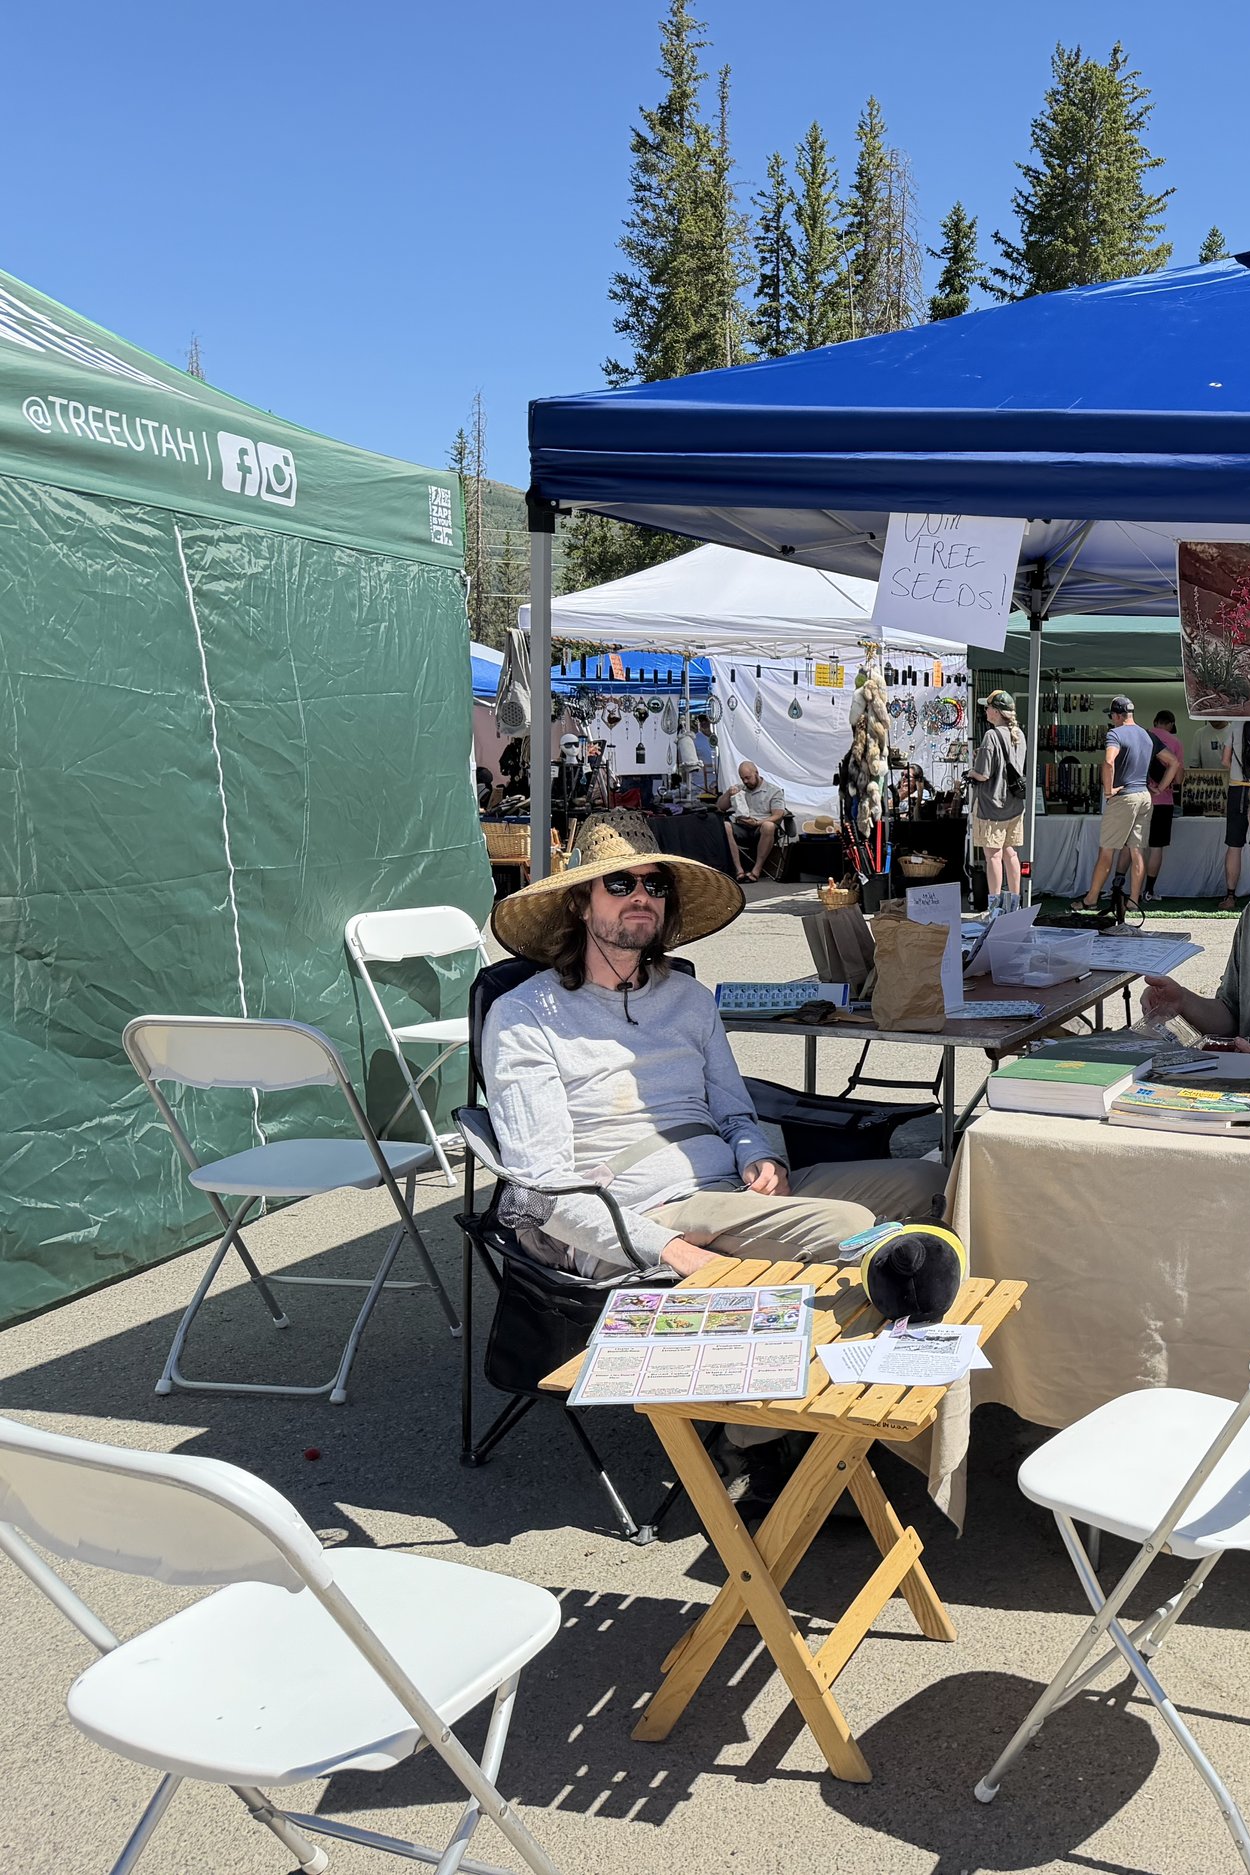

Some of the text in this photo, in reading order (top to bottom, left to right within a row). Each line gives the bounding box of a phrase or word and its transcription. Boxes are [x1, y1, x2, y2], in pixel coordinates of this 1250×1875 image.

[22, 395, 200, 466] @TREEUTAH
[432, 506, 448, 518] ZAP
[913, 534, 986, 570] FREE
